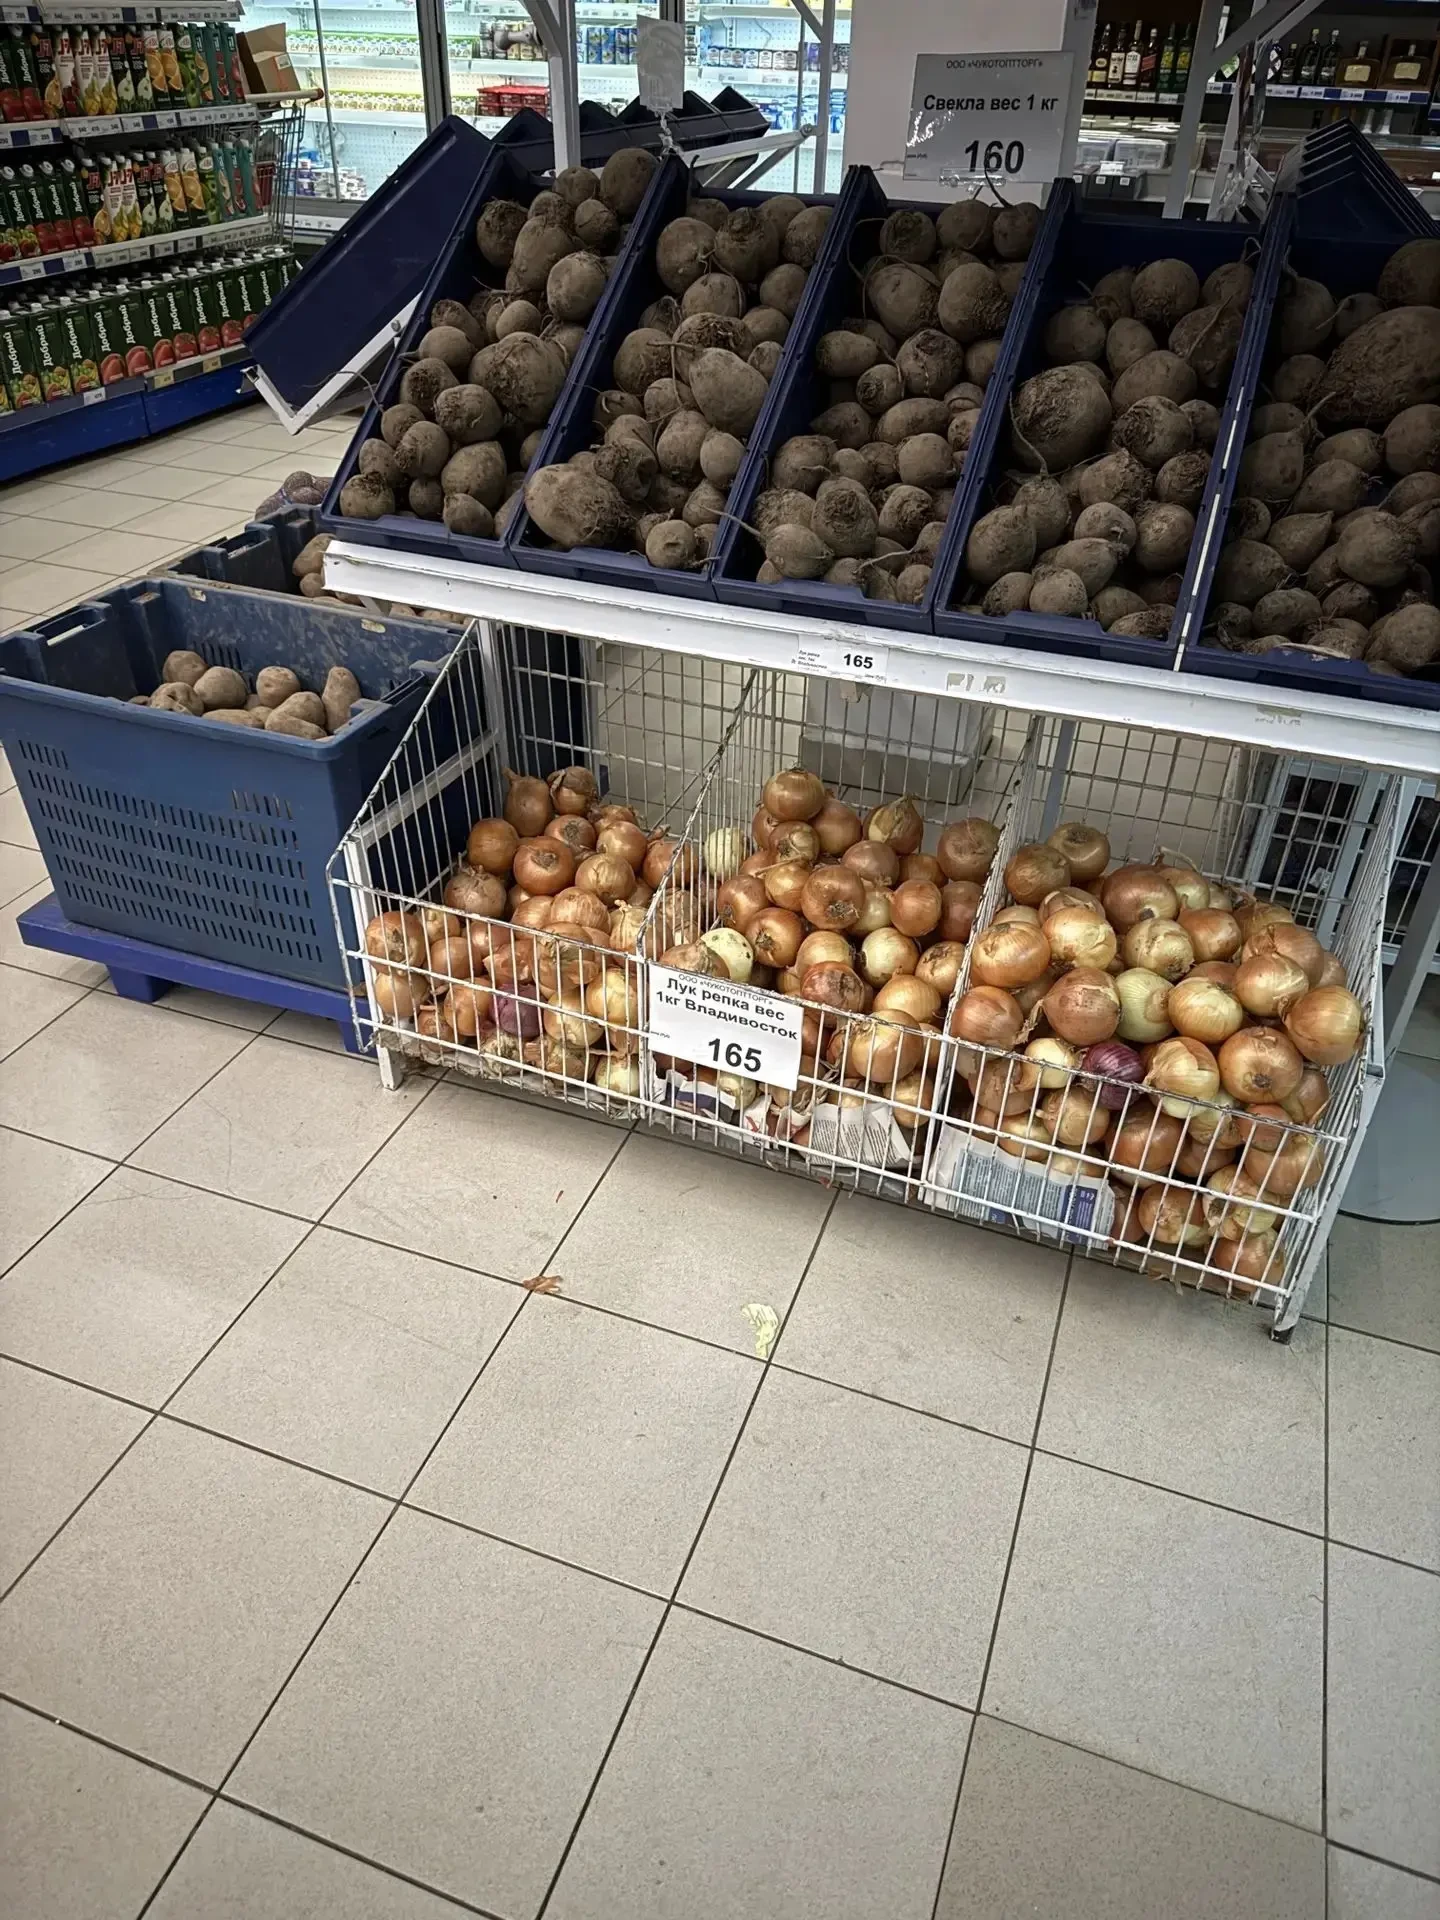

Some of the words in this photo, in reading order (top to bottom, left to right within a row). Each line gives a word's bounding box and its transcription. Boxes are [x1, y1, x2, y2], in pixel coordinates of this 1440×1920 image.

[17, 48, 32, 83] Добрый
[946, 60, 966, 69] ООО
[923, 94, 985, 111] Свекла
[990, 98, 1021, 111] вес
[1027, 94, 1035, 111] 1
[1041, 98, 1059, 111] кг
[964, 140, 1024, 174] 160
[9, 190, 25, 222] Добрый
[28, 187, 44, 219] Добрый
[49, 184, 63, 216] Добрый
[69, 181, 83, 213] Добрый
[166, 292, 182, 330] Добрый
[193, 287, 207, 325] Добрый
[216, 281, 230, 318] Добрый
[237, 275, 252, 312] Добрый
[94, 312, 111, 352] Добрый
[119, 304, 136, 344] Добрый
[148, 298, 162, 338] Добрый
[2, 332, 23, 375] Добрый
[35, 325, 54, 367] Добрый
[65, 318, 82, 360] Добрый
[843, 653, 873, 669] 165
[678, 974, 698, 984] ООО
[656, 991, 681, 1006] 1кг
[685, 998, 798, 1040] Владивосток
[667, 978, 697, 996] Лук
[702, 989, 749, 1011] репка
[755, 1004, 785, 1021] вес
[708, 1037, 762, 1073] 165
